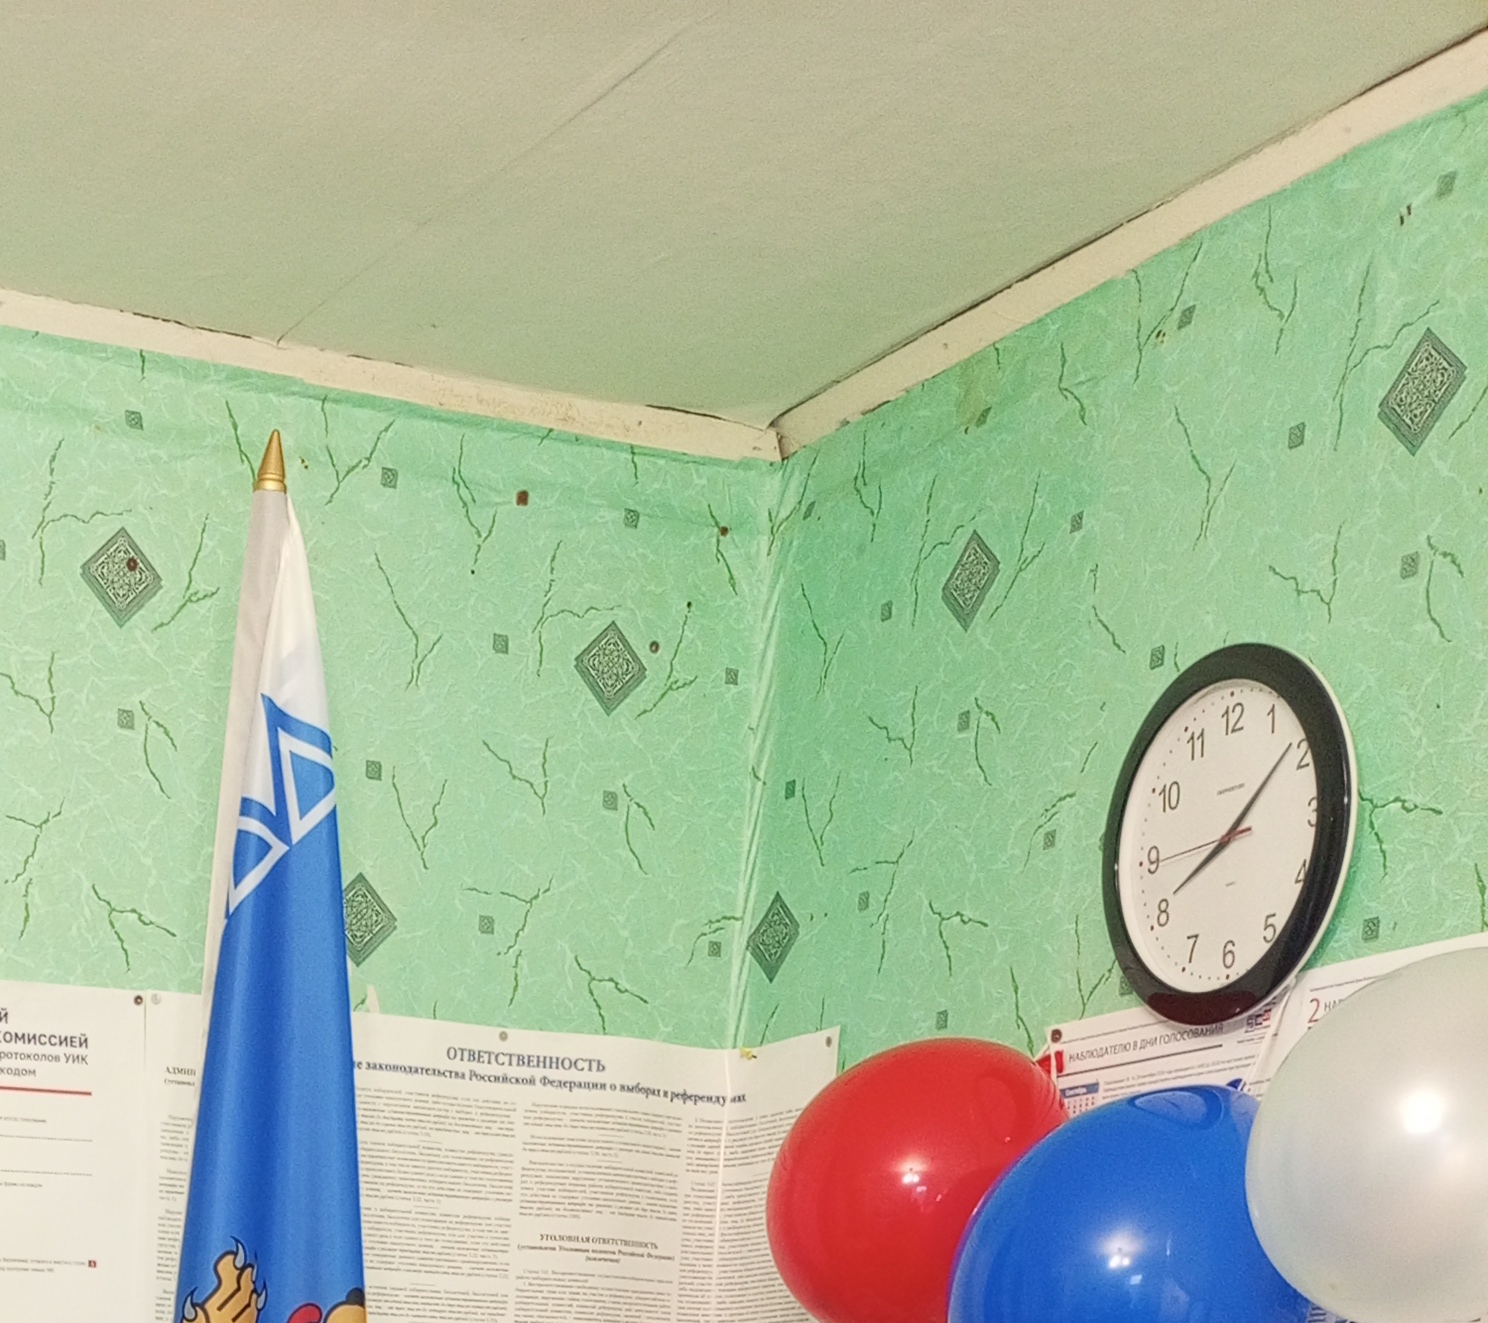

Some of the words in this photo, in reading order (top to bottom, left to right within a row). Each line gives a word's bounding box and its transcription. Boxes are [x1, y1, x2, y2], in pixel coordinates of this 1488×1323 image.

[1221, 702, 1245, 735] 12
[1267, 703, 1276, 734] 1
[1186, 728, 1205, 761] 11
[1296, 737, 1310, 770] 2
[1158, 781, 1180, 813] 10
[1147, 845, 1160, 874] 9
[1294, 858, 1308, 888] 4
[1157, 897, 1170, 928] 8
[1263, 912, 1278, 944] 5
[1186, 933, 1200, 964] 7
[1222, 939, 1236, 969] 6
[1308, 998, 1320, 1023] 2
[63, 1052, 89, 1066] УИК
[1068, 1042, 1131, 1064] НАБЛЮДАТЕЛЮ
[1132, 1041, 1138, 1051] В
[1139, 1038, 1158, 1051] ДНИ
[1159, 1023, 1224, 1046] ГОЛОСОВАНИЯ
[0, 1067, 37, 1077] кодом
[446, 1046, 606, 1073] ОТВЕТСТВЕННОСТЬ
[365, 1059, 466, 1081] законодательства
[468, 1069, 536, 1087] Российской
[539, 1075, 607, 1093] Федерации
[609, 1083, 617, 1091] о
[619, 1082, 662, 1099] выборах
